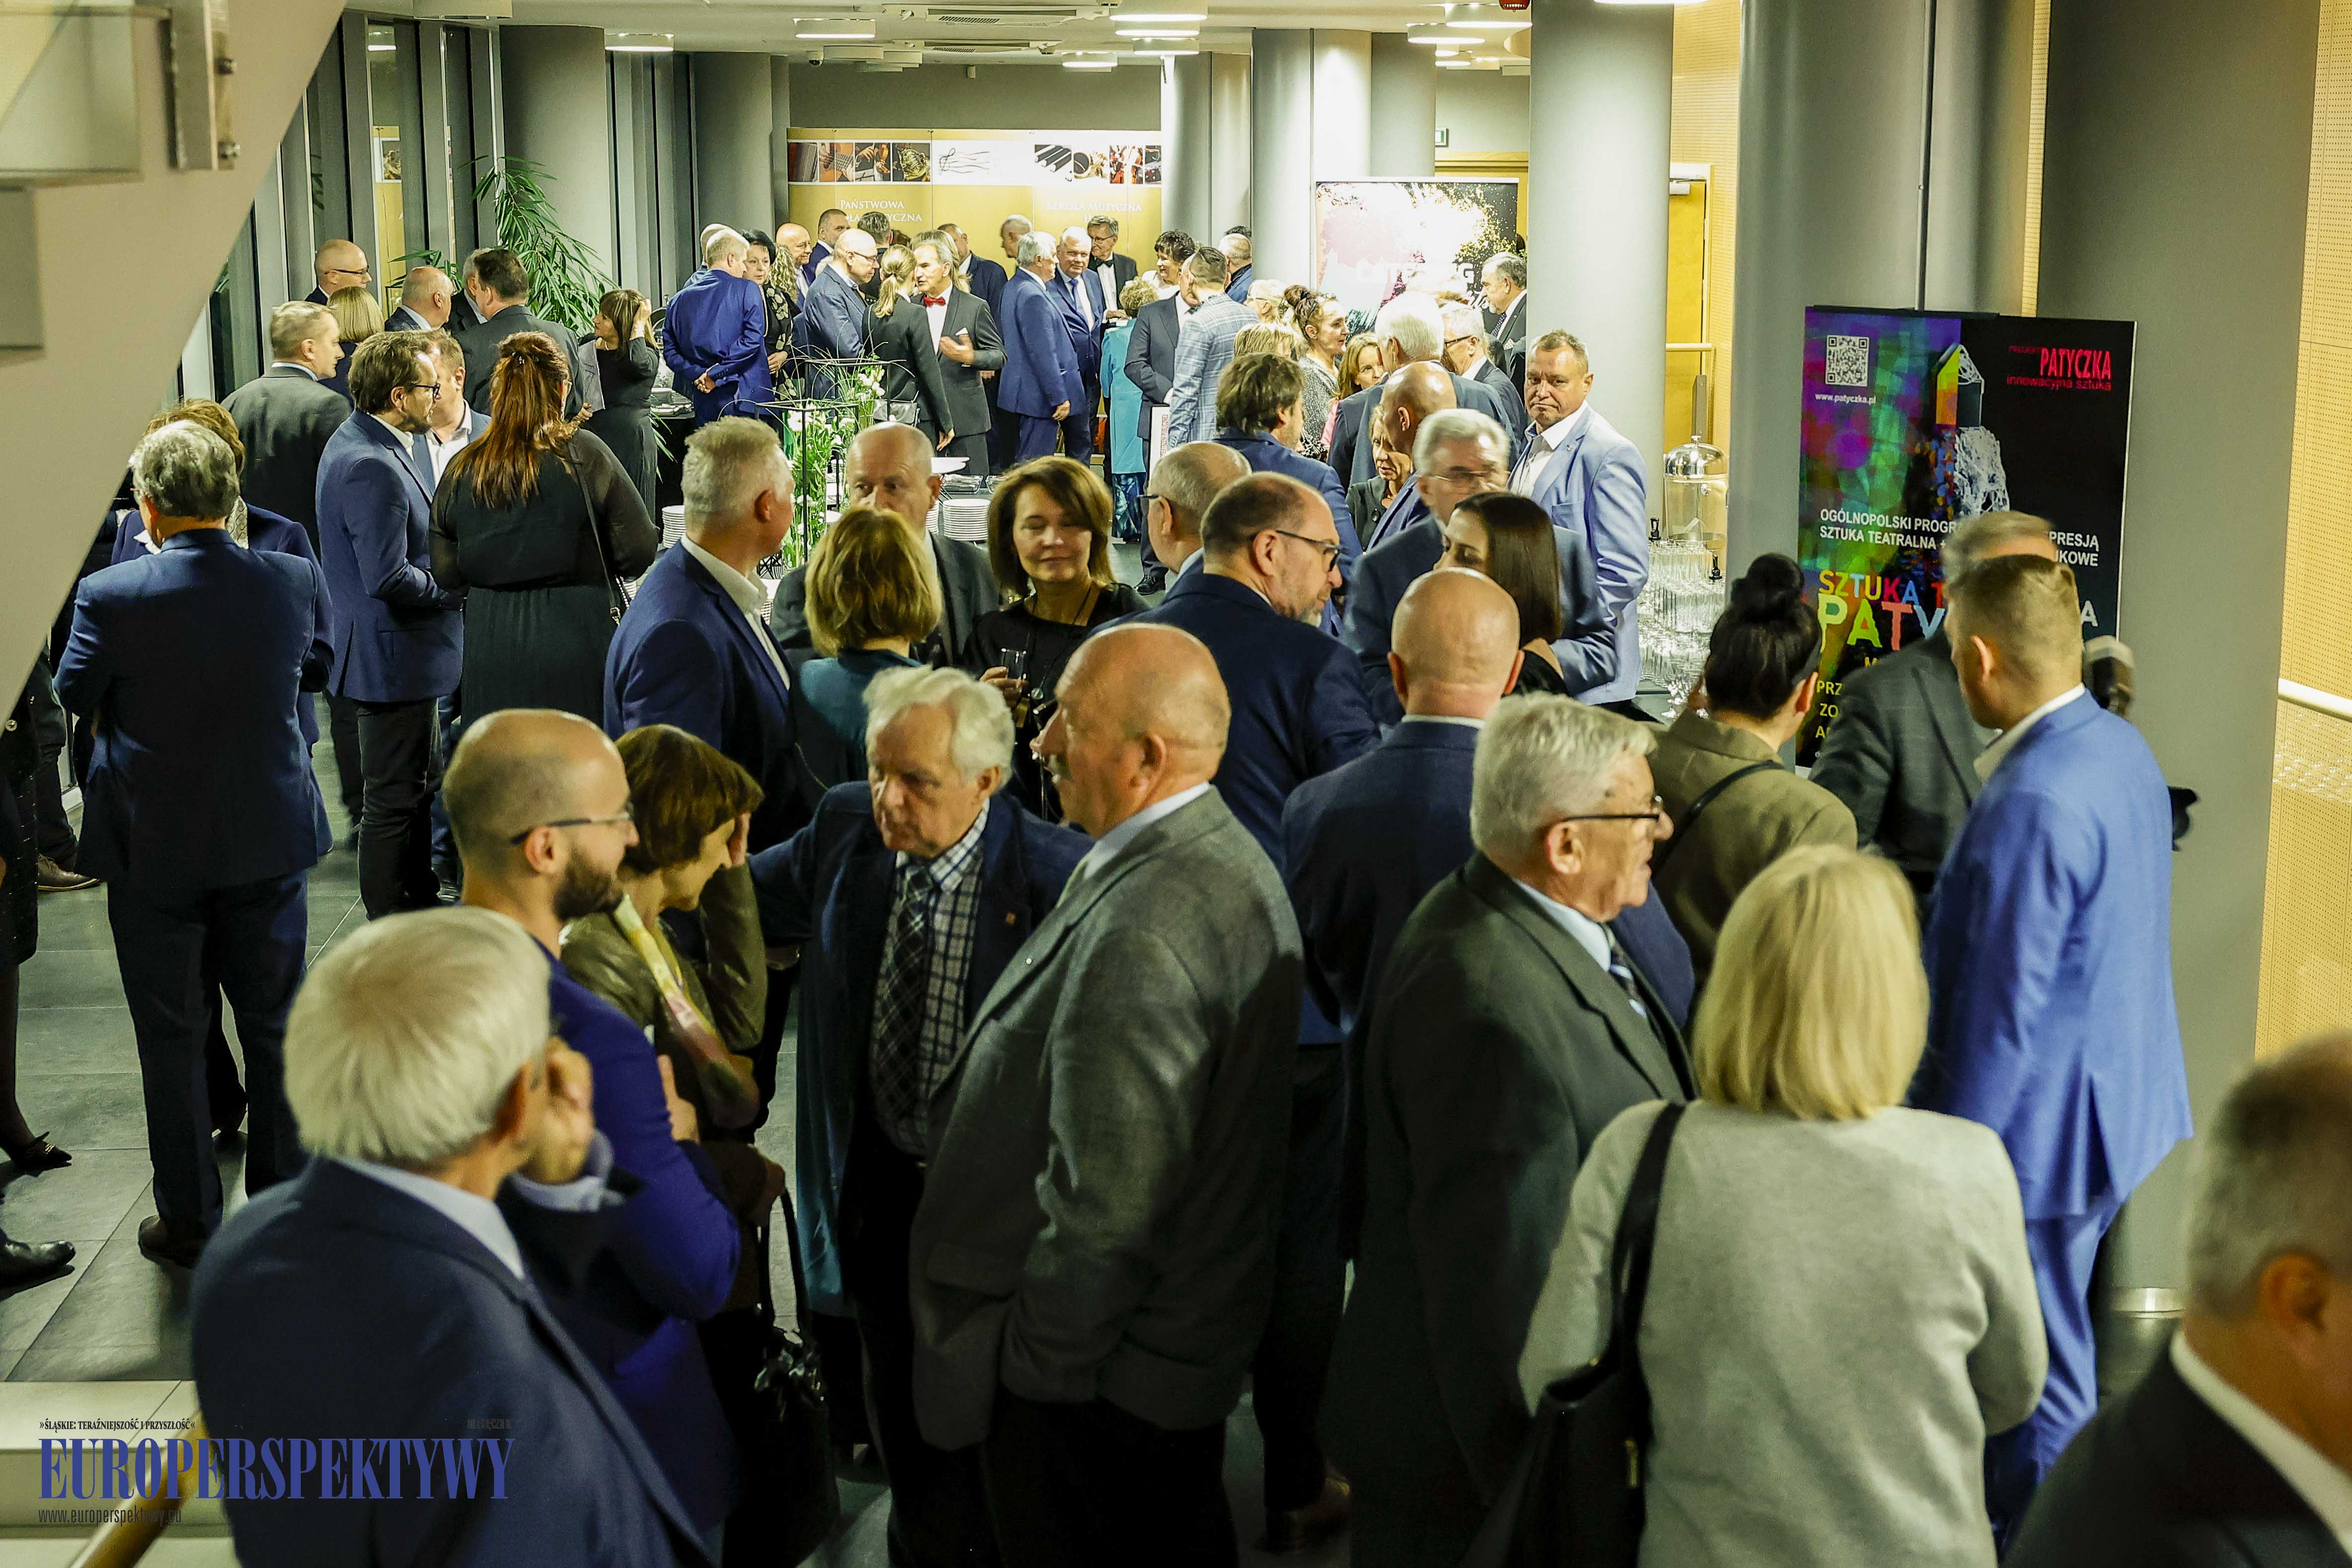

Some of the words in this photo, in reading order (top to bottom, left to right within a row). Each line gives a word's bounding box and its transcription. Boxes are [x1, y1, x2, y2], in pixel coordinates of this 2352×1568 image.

[840, 199, 905, 209] PAŃSTWOWA
[1089, 202, 1142, 212] MUZYCZNA
[884, 213, 923, 222] YCZNA
[2040, 347, 2111, 380] PATYCZKA
[2076, 379, 2112, 392] sztuka
[1815, 394, 1876, 405] www.patyczka.pl
[1820, 507, 1912, 530] OGÓLNOPOLSKI
[1914, 518, 1957, 534] PROGR
[2049, 531, 2100, 552] PRESJĄ
[1820, 525, 1864, 542] SZTUKA
[1867, 530, 1937, 550] TEATRALNA
[1818, 569, 1920, 605] SZTUKA
[1817, 592, 1946, 654] PATY
